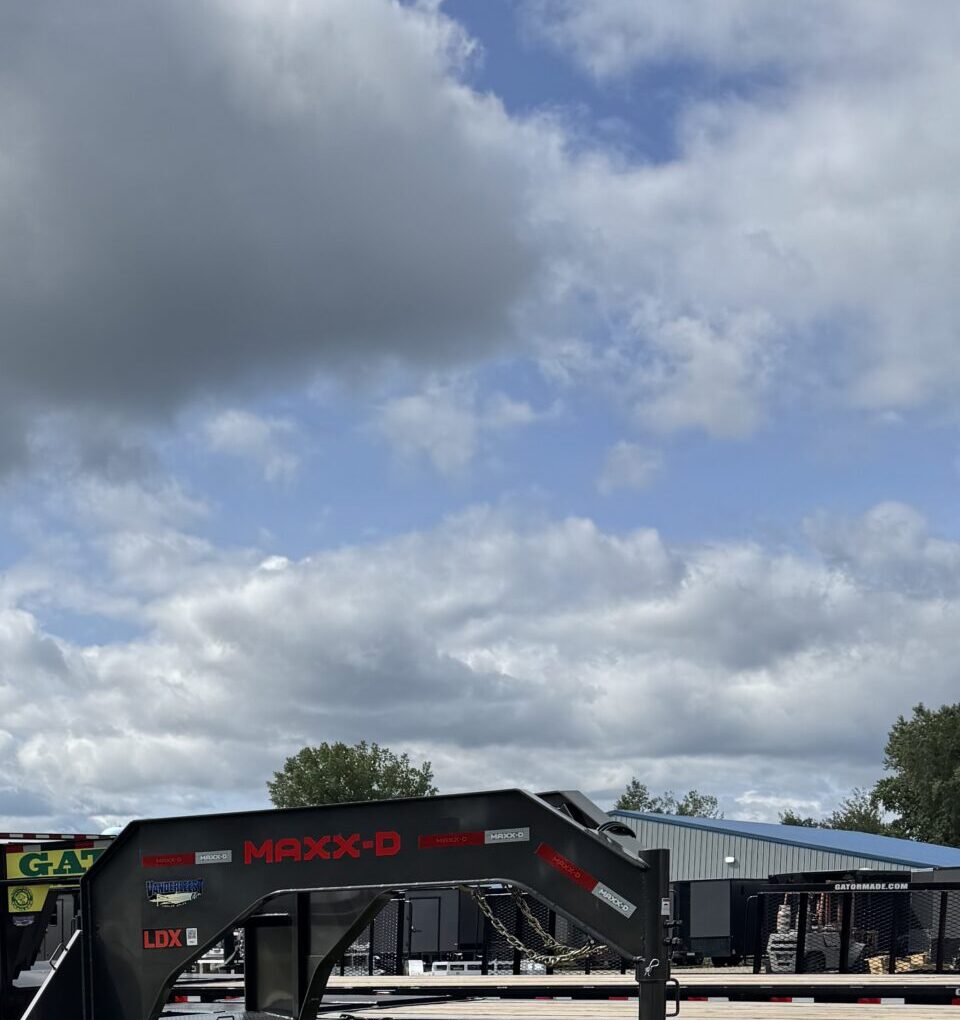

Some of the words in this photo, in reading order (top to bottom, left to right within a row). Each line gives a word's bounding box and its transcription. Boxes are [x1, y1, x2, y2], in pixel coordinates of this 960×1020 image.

[490, 830, 524, 840] MAXX-D
[244, 831, 401, 865] MAXX-D
[199, 853, 228, 861] MAXX-D
[834, 883, 909, 891] GATORMADE.COM
[599, 888, 630, 912] MAXX-D
[143, 929, 182, 949] LDX
